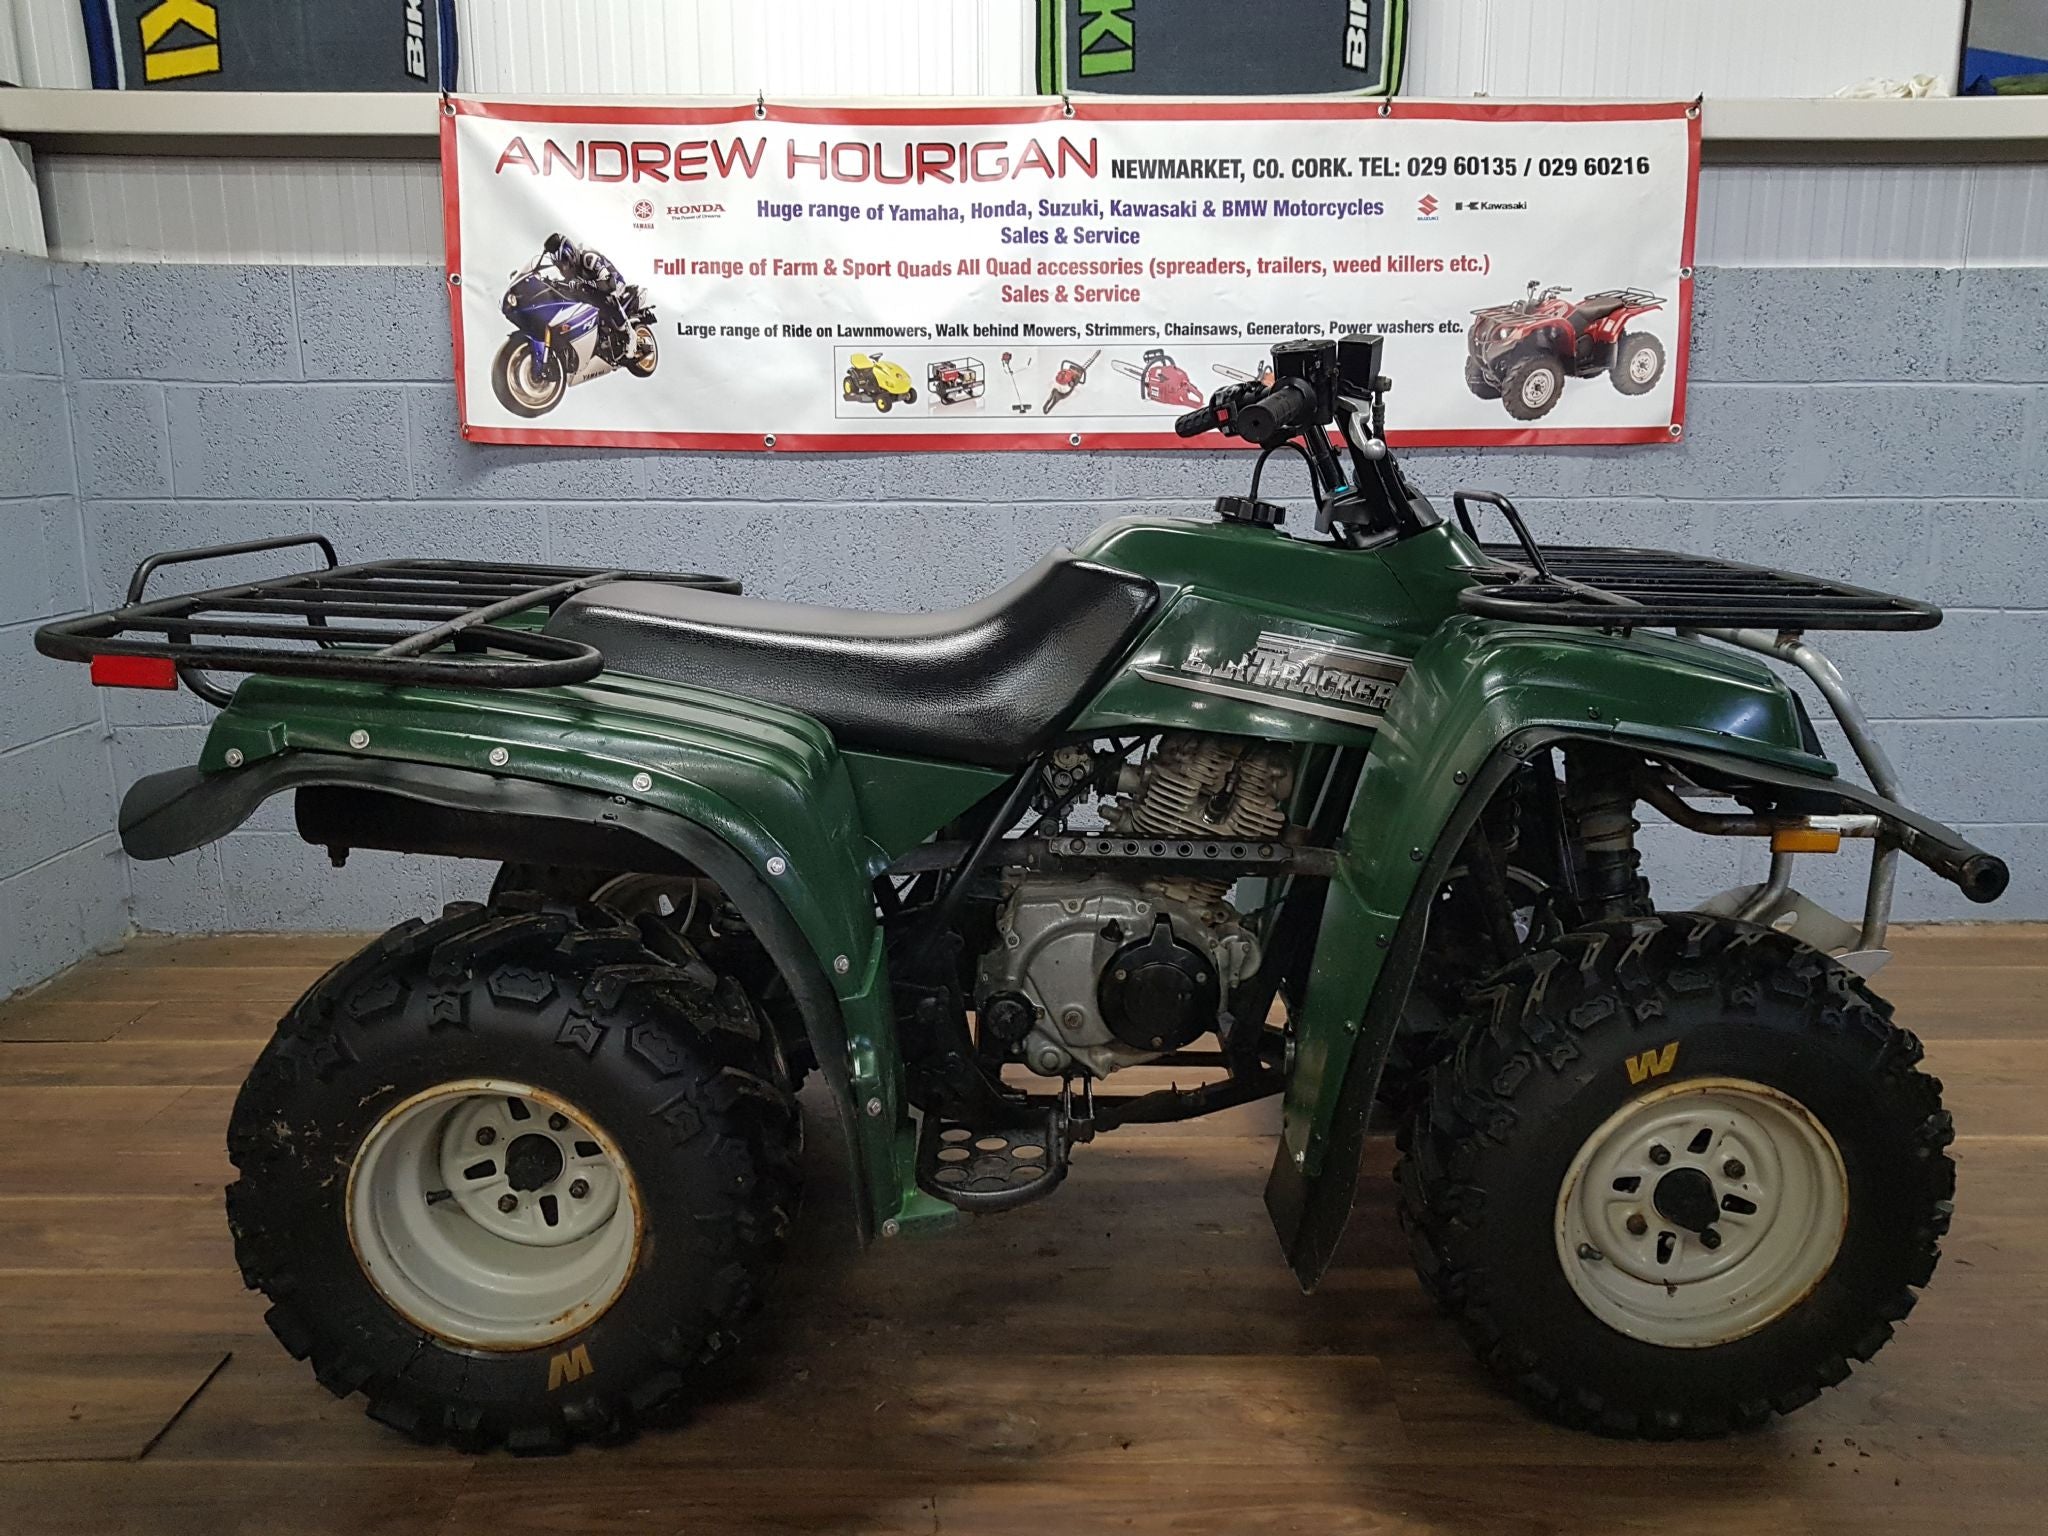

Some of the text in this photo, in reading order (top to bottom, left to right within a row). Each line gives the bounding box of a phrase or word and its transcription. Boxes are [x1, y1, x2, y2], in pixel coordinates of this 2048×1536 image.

[495, 136, 1098, 185] ANDREW HOURIGAN
[1112, 156, 1649, 183] NEWMARKET, CO. CORK. TEL: 029 60135 / 029 60216
[667, 204, 726, 214] HONDA
[758, 198, 1383, 223] Huge range of Yamaha, Honda, Suzuki, Kawasaki & BMW Motorcycles
[1481, 201, 1527, 209] Kawasaki
[1001, 227, 1140, 244] Sales & Service
[654, 254, 1489, 279] Full range of Farm & Sport Quads All Quad accessories (spreaders, trailers, weed killers etc.)
[1002, 285, 1140, 302] Sales & Service
[678, 320, 1463, 340] Large range of Ride on Lawnmowers, Walk behind Mowers, Strimmers, Chainsaws, Generators, Power washers etc.
